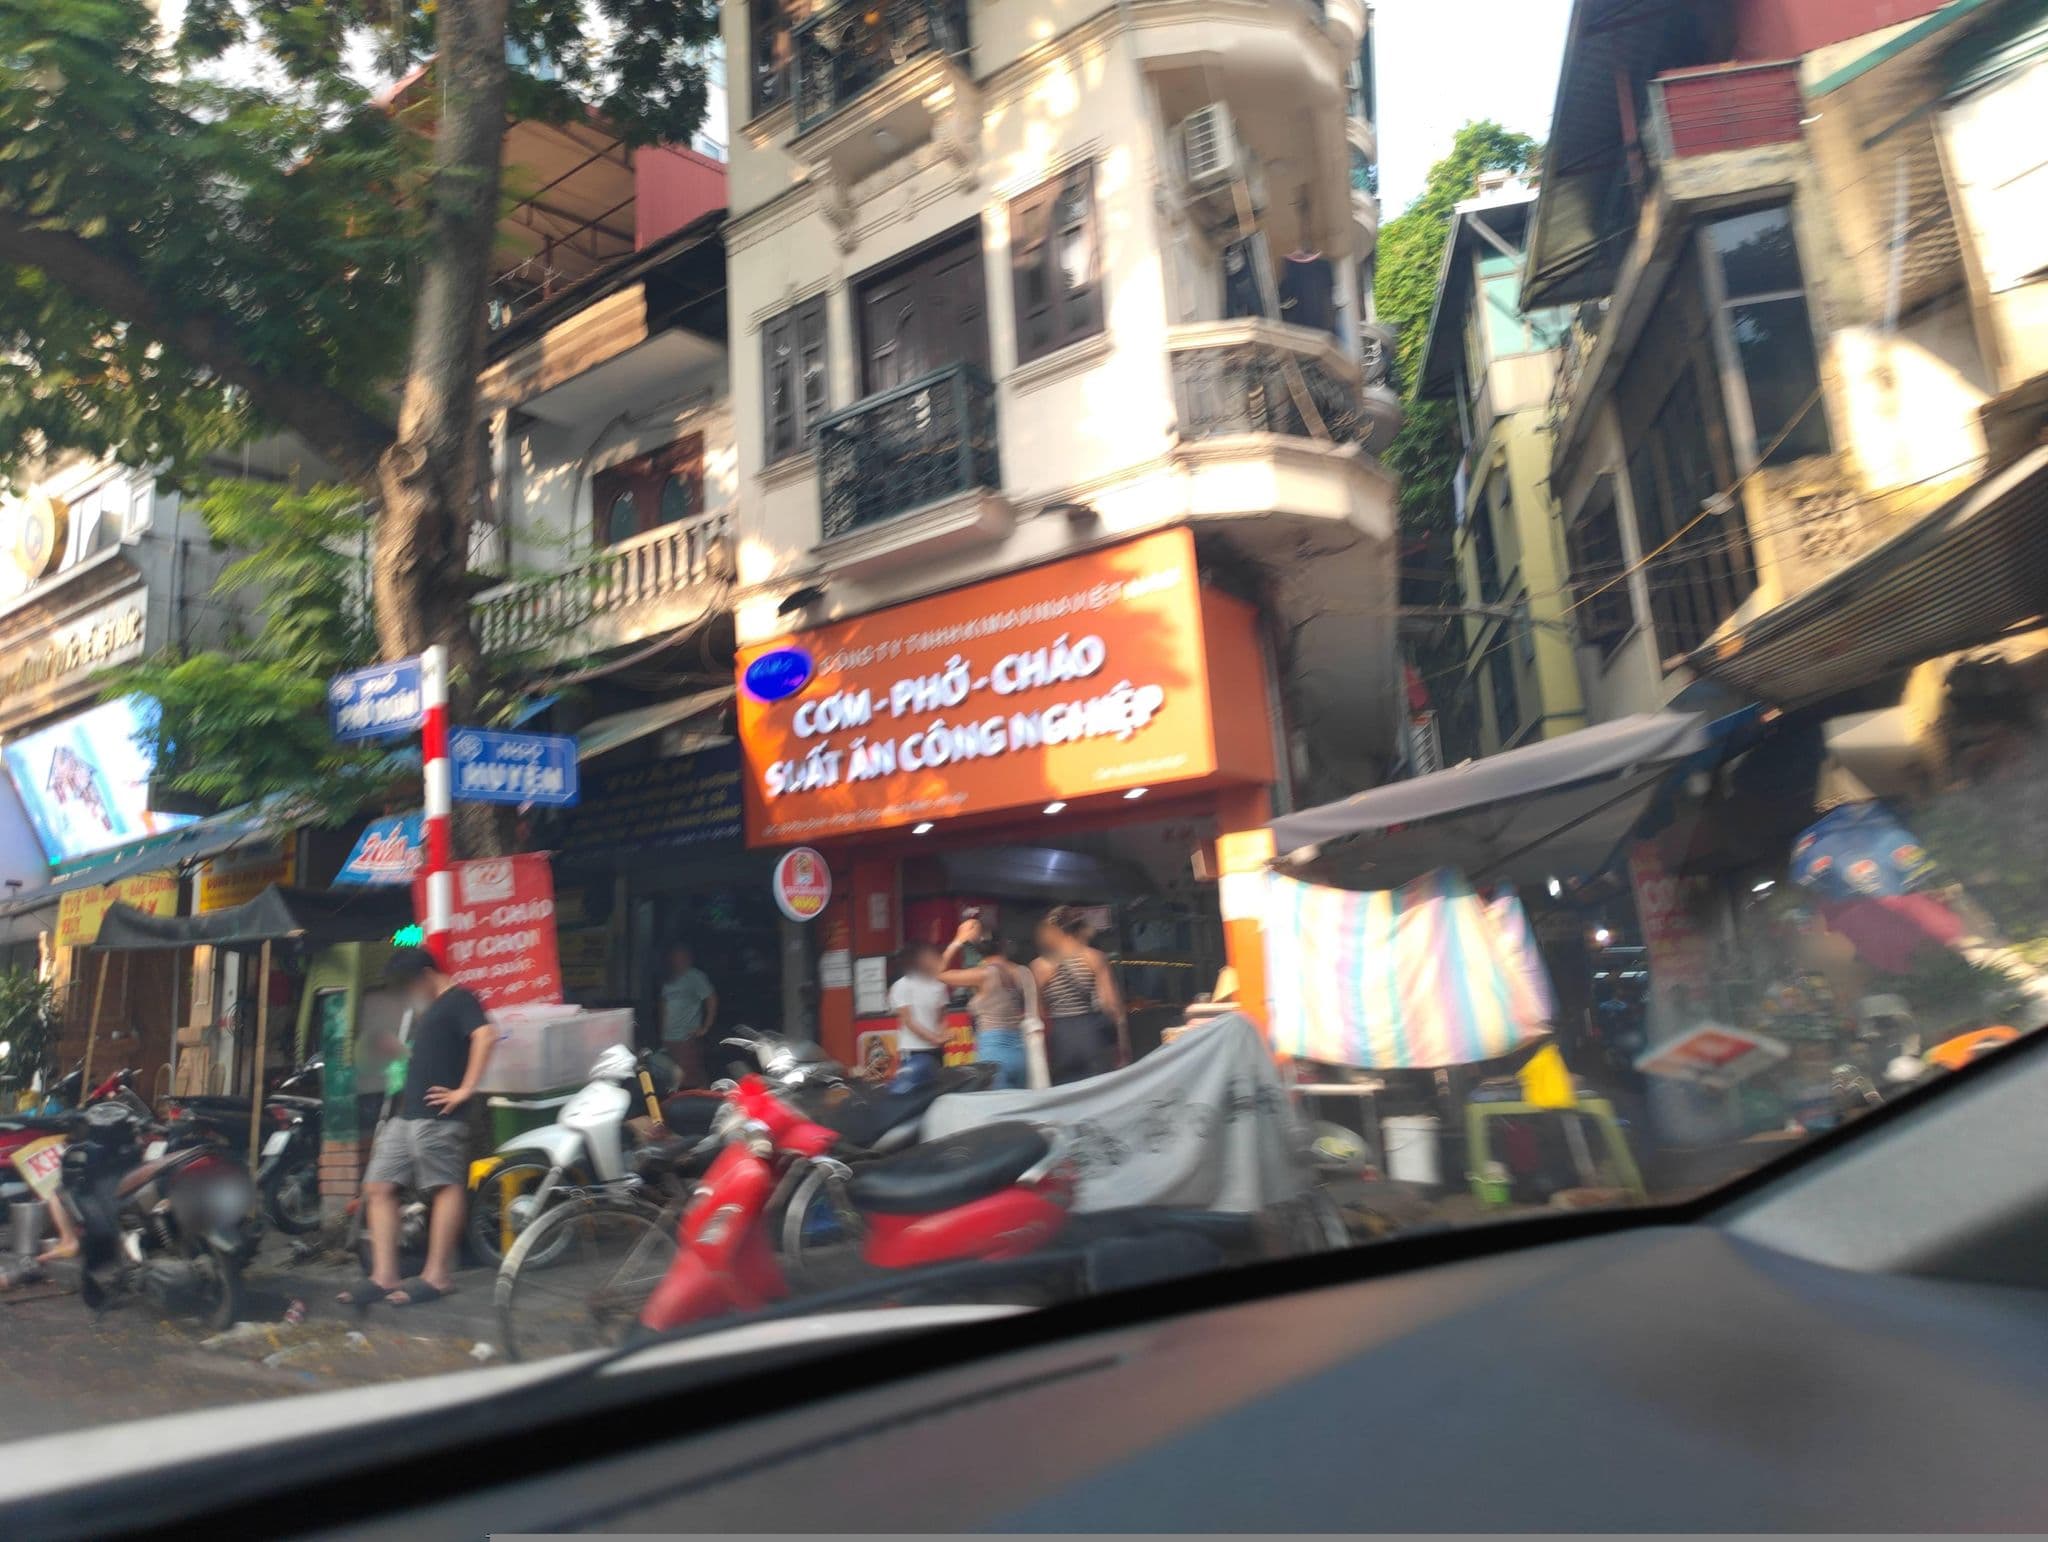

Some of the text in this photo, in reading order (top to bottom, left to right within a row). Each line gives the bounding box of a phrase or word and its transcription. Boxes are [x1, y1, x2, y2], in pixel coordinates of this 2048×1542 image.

[792, 687, 872, 738] CƠM
[889, 653, 970, 718] PHỞ
[990, 632, 1106, 695] CHÁO
[845, 736, 898, 784] ĂN
[900, 718, 1008, 773] CÔNG
[1008, 679, 1164, 751] NGHIỆP
[461, 760, 564, 794] HUYỆN
